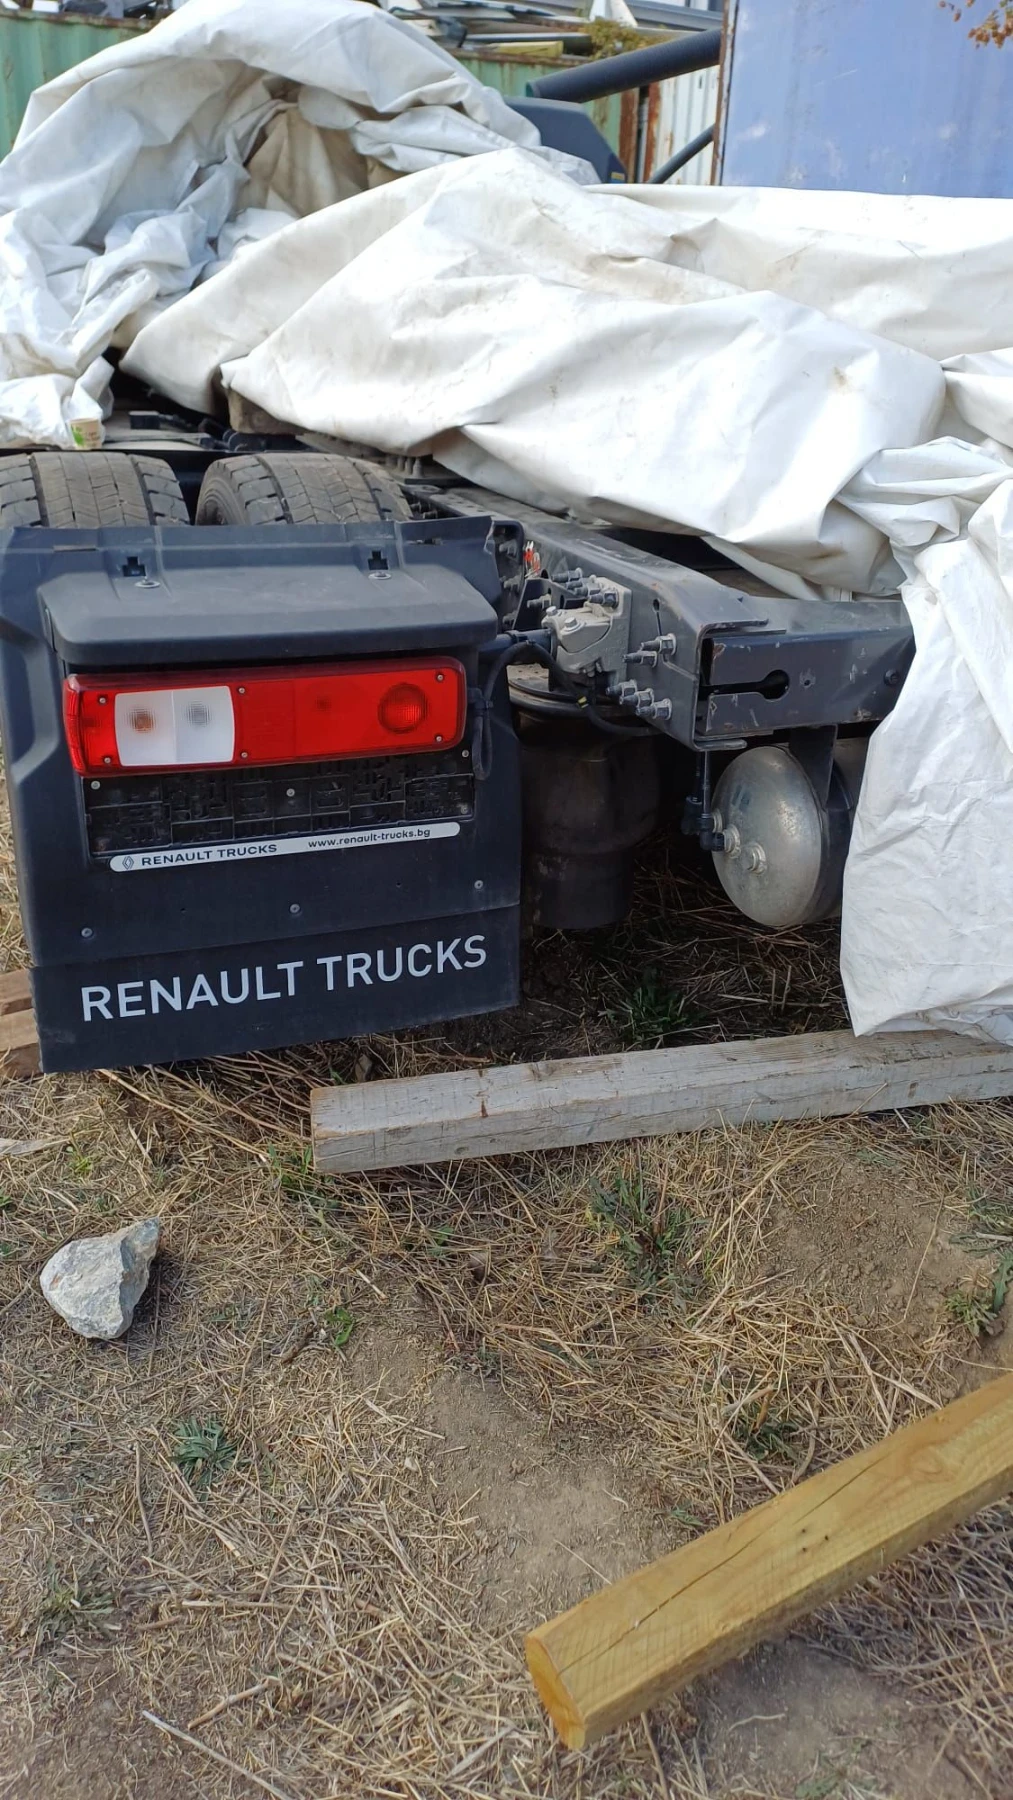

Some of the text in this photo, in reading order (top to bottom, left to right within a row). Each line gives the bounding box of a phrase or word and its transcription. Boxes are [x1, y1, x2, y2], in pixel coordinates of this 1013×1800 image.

[308, 828, 431, 848] www.renault-trucks.bg
[141, 844, 277, 866] RENAULT TRUCKS
[81, 934, 487, 1022] RENAULT TRUCKS
